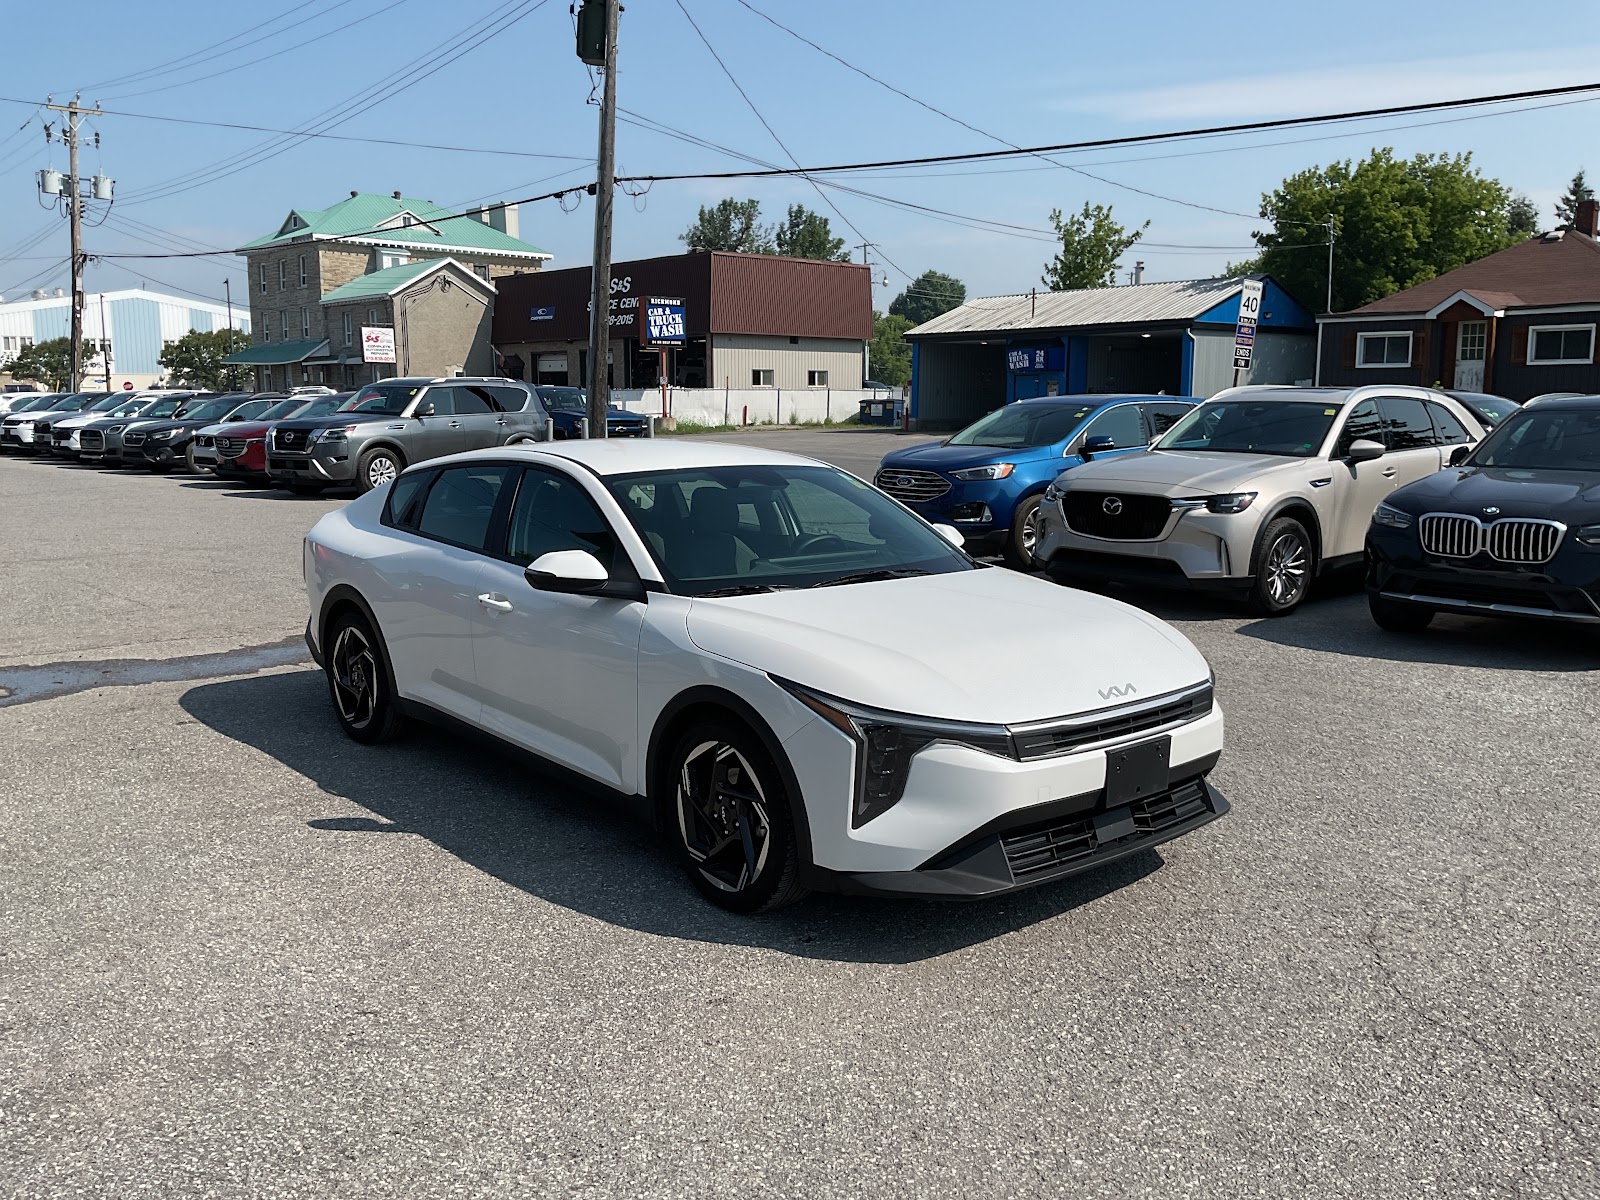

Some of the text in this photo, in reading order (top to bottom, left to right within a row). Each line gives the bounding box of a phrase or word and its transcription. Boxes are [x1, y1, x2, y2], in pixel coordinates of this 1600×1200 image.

[609, 276, 632, 294] S&S
[650, 298, 681, 306] RICHMOND
[1242, 296, 1258, 313] 40
[647, 306, 671, 317] CAR &
[648, 313, 683, 326] TRUCK
[649, 323, 684, 338] WASH
[1008, 353, 1029, 363] TRUCK
[1236, 348, 1250, 357] ENDS
[1009, 359, 1029, 370] WASH
[1238, 359, 1246, 367] FIN
